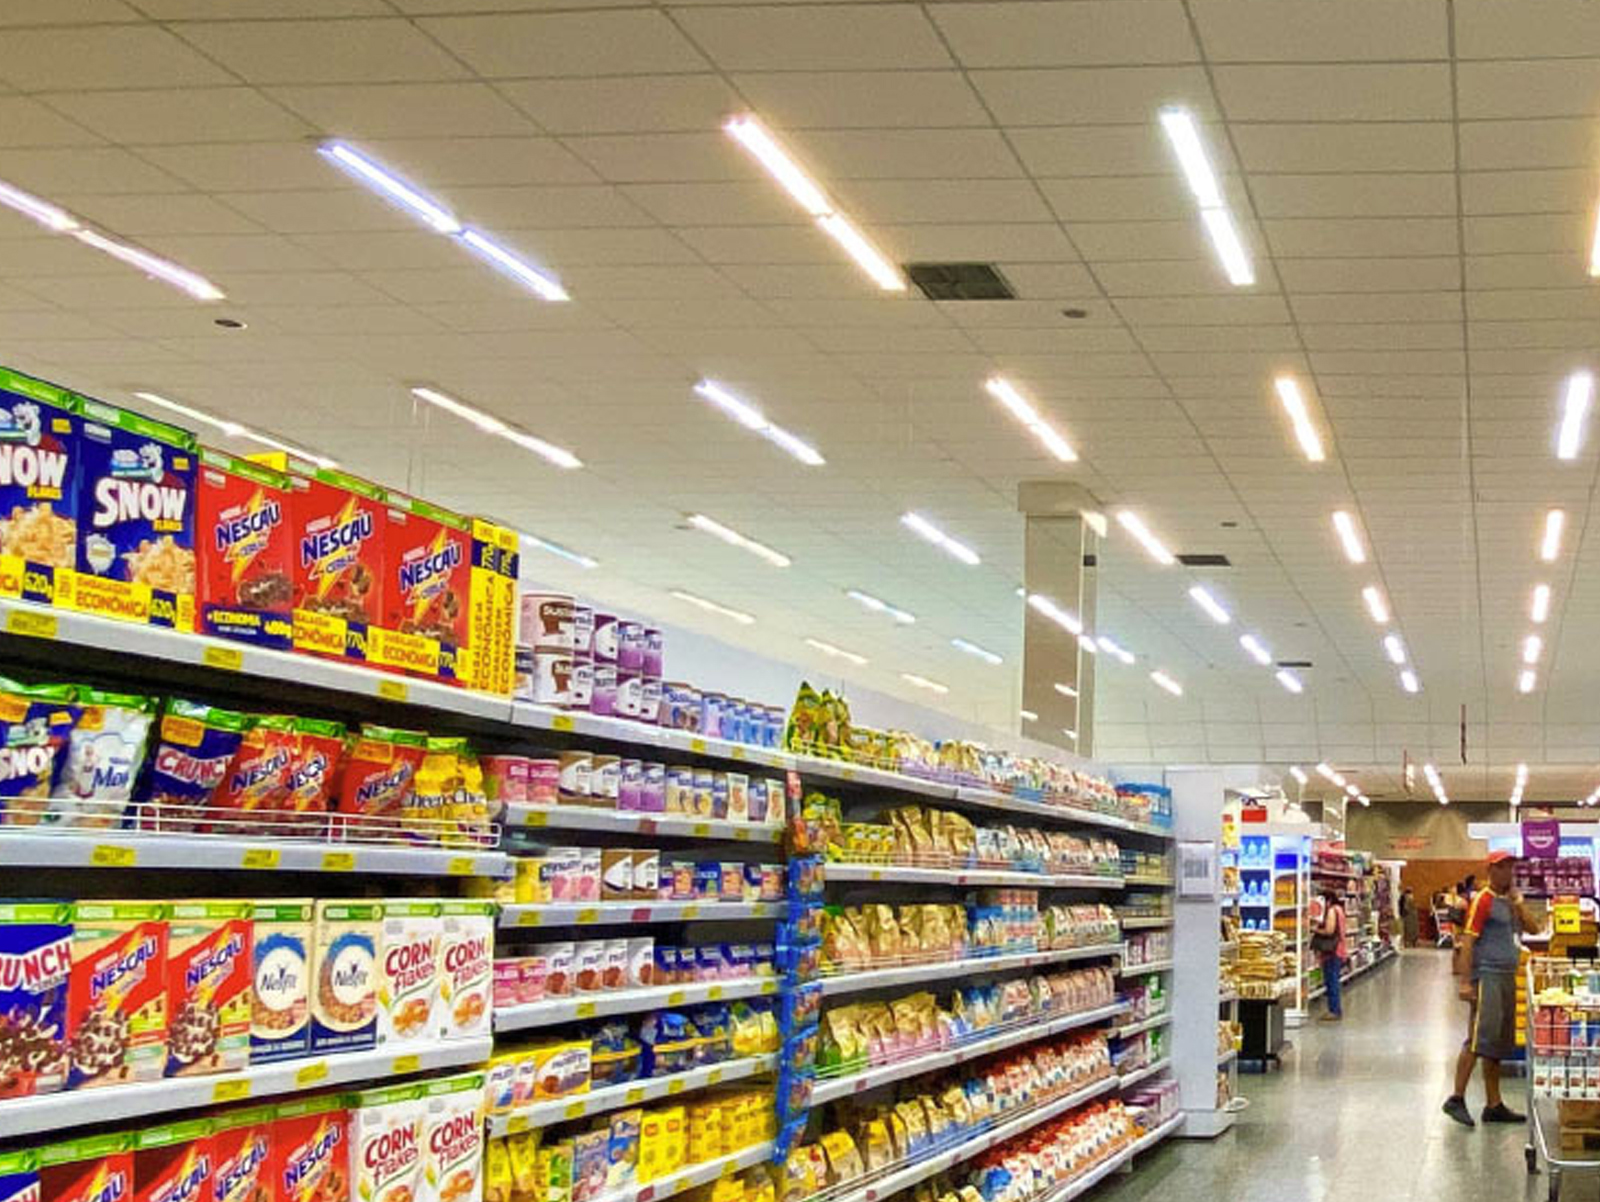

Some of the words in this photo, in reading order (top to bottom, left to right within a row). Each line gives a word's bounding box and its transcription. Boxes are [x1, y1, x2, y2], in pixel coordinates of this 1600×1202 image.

[93, 478, 187, 527] SNOW
[216, 503, 280, 549] NESCAU
[302, 513, 372, 566] NESCAU
[400, 544, 461, 592] NESCAU
[229, 749, 288, 793] NESCAU
[92, 938, 157, 998] NESCAU
[187, 936, 244, 990] NESCAU
[385, 938, 432, 977] CORN
[445, 938, 485, 972] CORN
[365, 1123, 414, 1169] CORN
[431, 1112, 475, 1154] CORN
[285, 1124, 341, 1190] NESCAU
